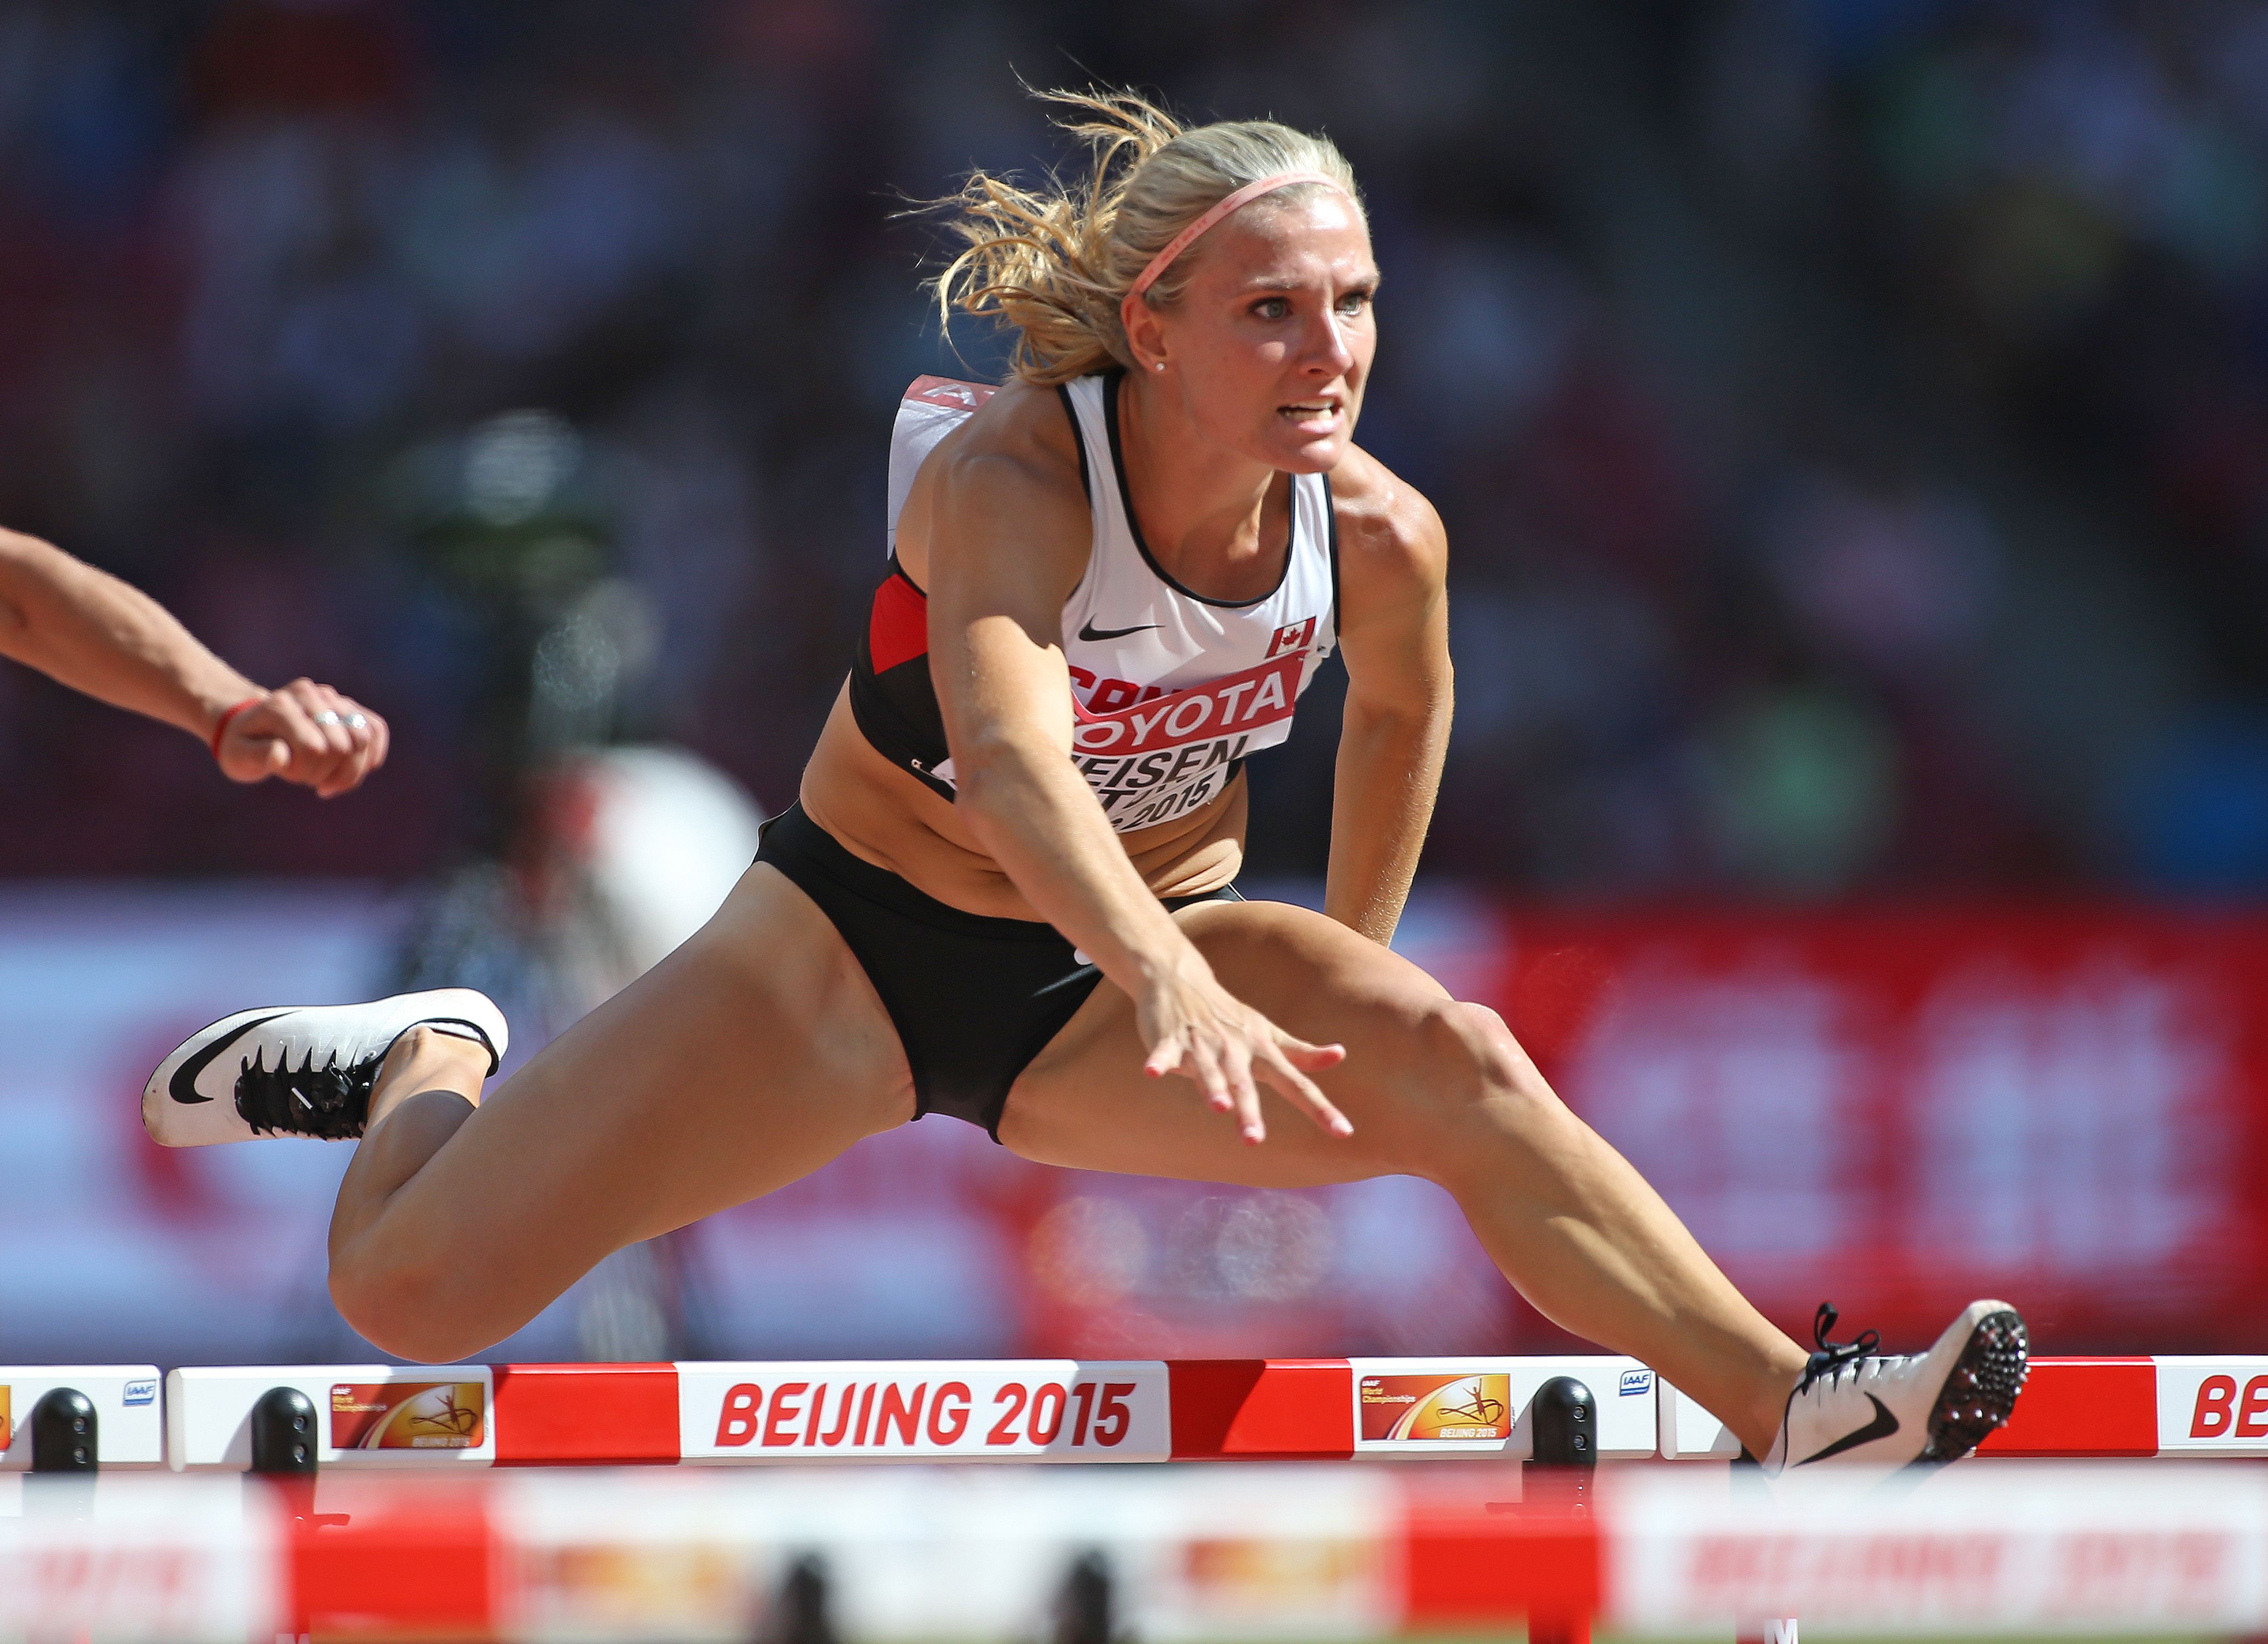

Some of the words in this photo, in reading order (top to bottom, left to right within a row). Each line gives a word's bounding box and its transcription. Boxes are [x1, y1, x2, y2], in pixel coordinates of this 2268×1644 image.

[1073, 671, 1286, 749] OYOTA
[1072, 735, 1249, 788] EISEN
[1120, 770, 1218, 830] 2015
[1623, 1374, 1650, 1385] IAAF
[715, 1382, 971, 1447] BEIJING
[984, 1382, 1136, 1446] 2015
[1439, 1428, 1475, 1438] BEIJING
[1476, 1428, 1497, 1437] 2015
